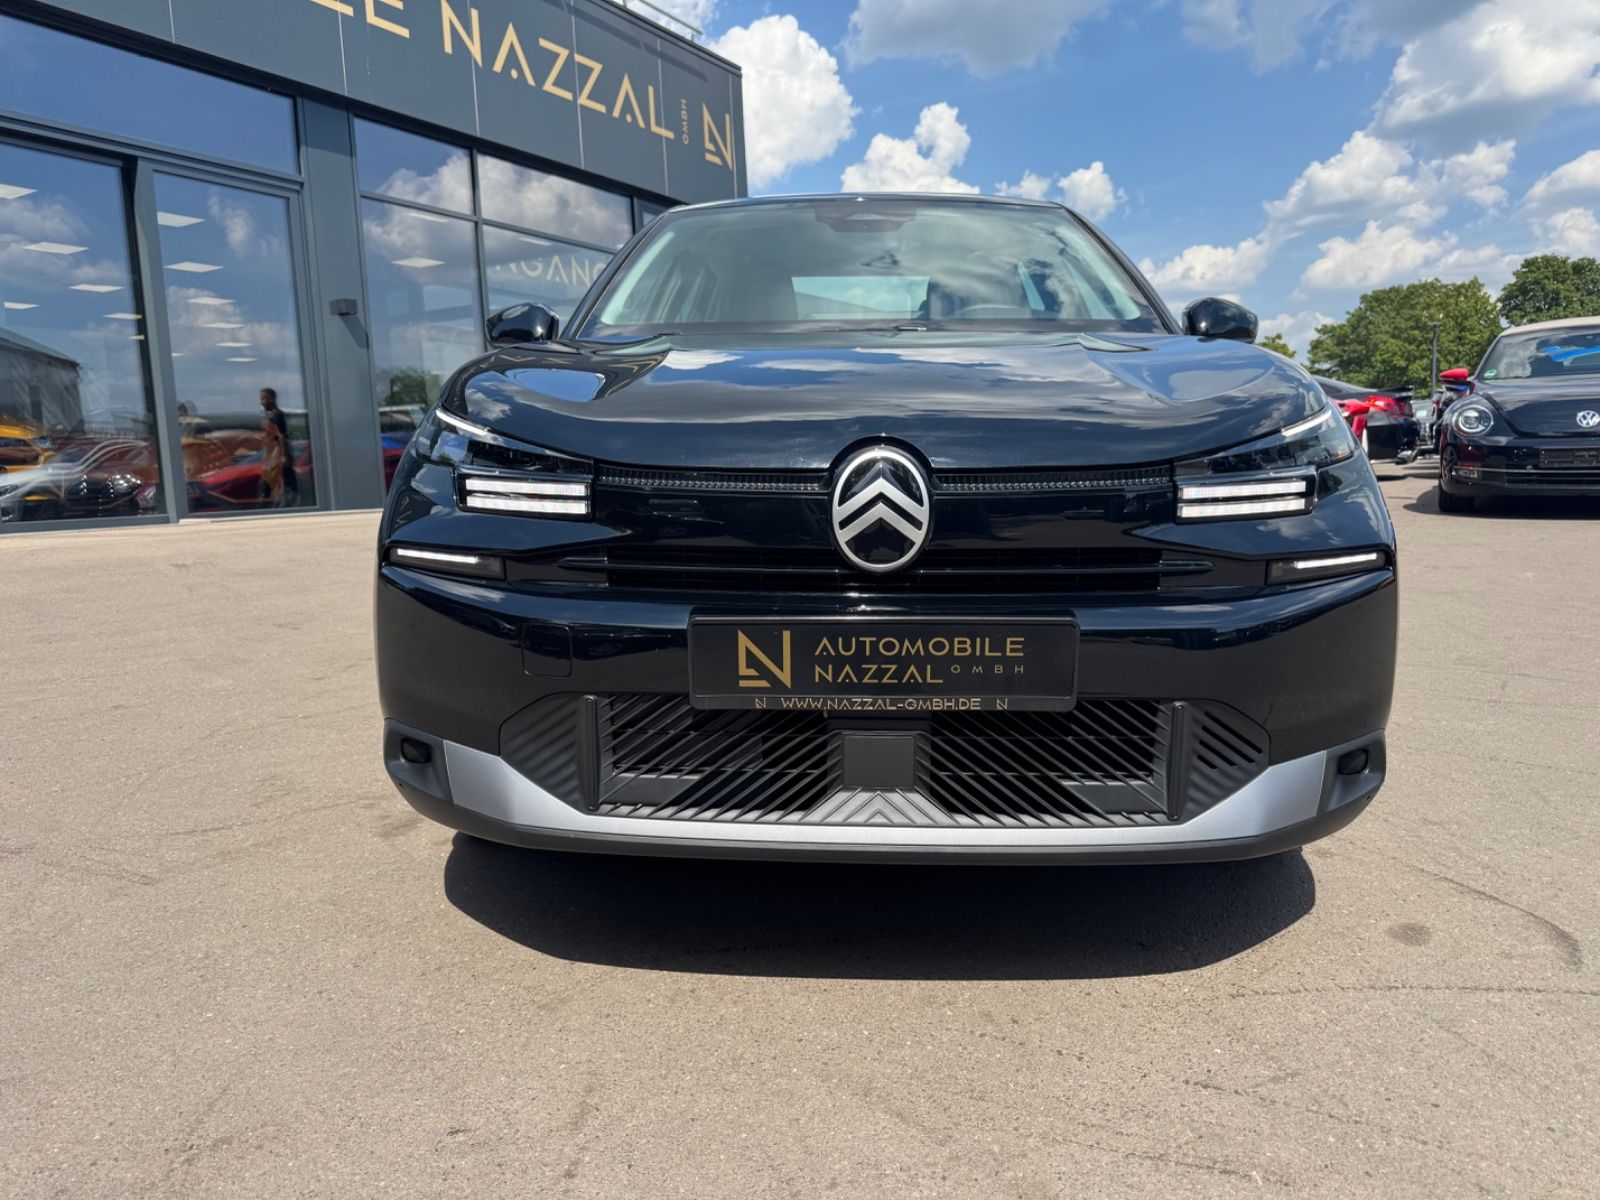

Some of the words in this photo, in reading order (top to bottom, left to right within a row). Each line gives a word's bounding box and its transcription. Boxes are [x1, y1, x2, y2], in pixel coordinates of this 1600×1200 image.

[440, 0, 675, 140] NAZZAL
[680, 98, 689, 145] GMBH
[814, 637, 1025, 657] AUTOMOBILE
[815, 663, 944, 684] NAZZAL
[781, 698, 982, 710] WWW.NAZZAL-GMBH.DE
